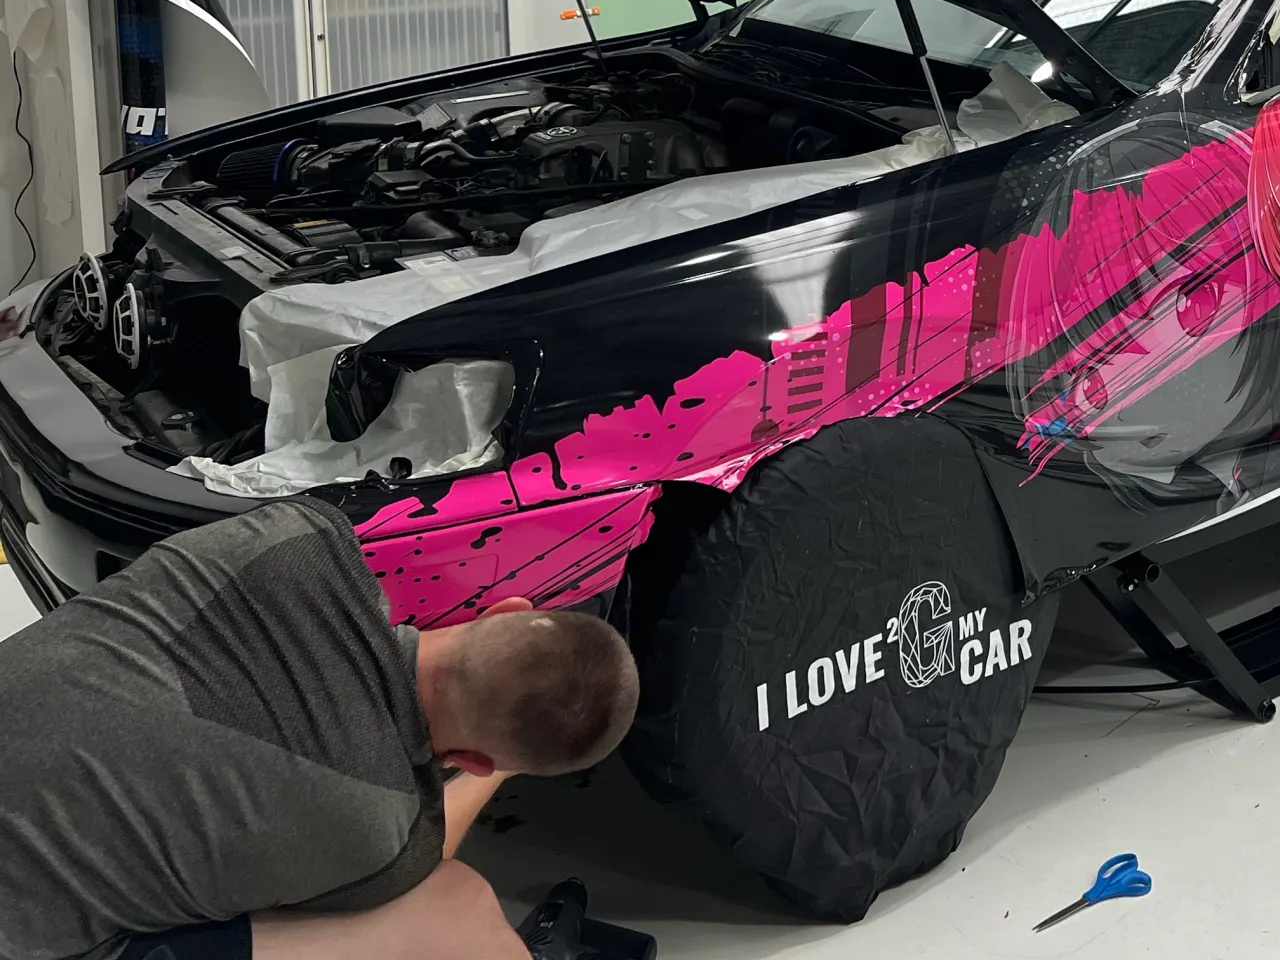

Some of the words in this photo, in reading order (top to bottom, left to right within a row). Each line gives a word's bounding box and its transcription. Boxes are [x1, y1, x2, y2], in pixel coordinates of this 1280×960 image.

[959, 607, 986, 641] MY
[959, 618, 1032, 686] CAR
[785, 633, 885, 719] LOVE
[757, 683, 769, 731] I
